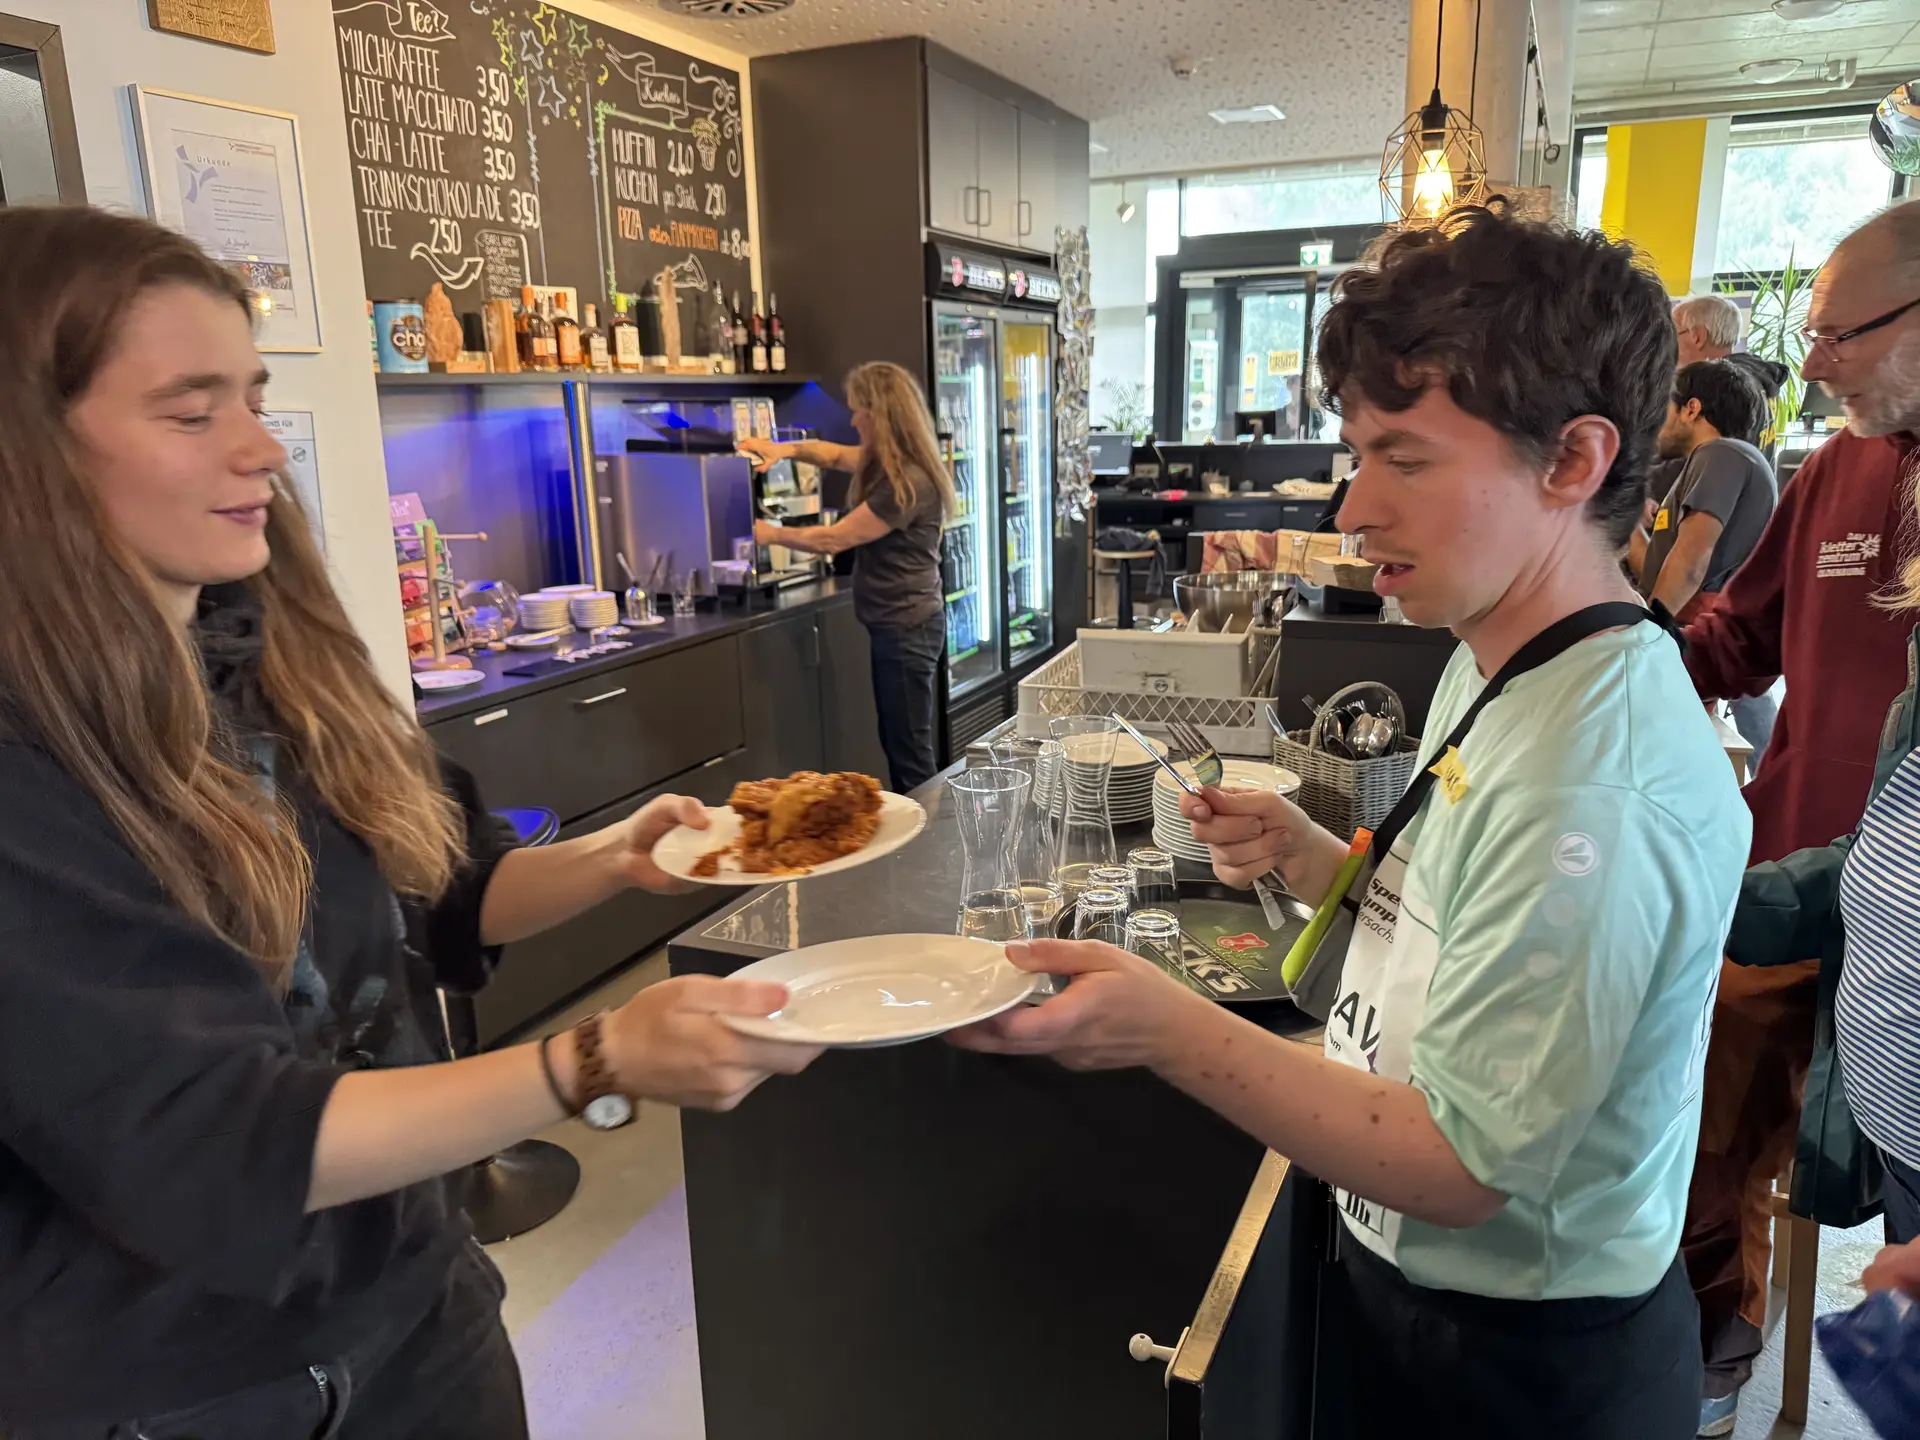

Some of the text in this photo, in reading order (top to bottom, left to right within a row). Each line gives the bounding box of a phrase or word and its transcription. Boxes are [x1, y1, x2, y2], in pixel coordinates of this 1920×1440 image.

[406, 2, 440, 34] Tee?
[339, 26, 510, 107] MILCHKAFFEE 3,50
[345, 72, 514, 143] LATTE MACCHIATO 3,50
[197, 156, 231, 168] Urkunde
[483, 145, 516, 182] 3,50
[611, 127, 657, 169] MUFFIN
[357, 165, 541, 230] TRINKSCHOKOLADE 3,50
[614, 166, 659, 206] KUCHEN
[362, 208, 397, 250] TEE
[616, 205, 644, 241] PIZZA
[1362, 893, 1397, 926] ymp
[1370, 877, 1400, 907] Spe
